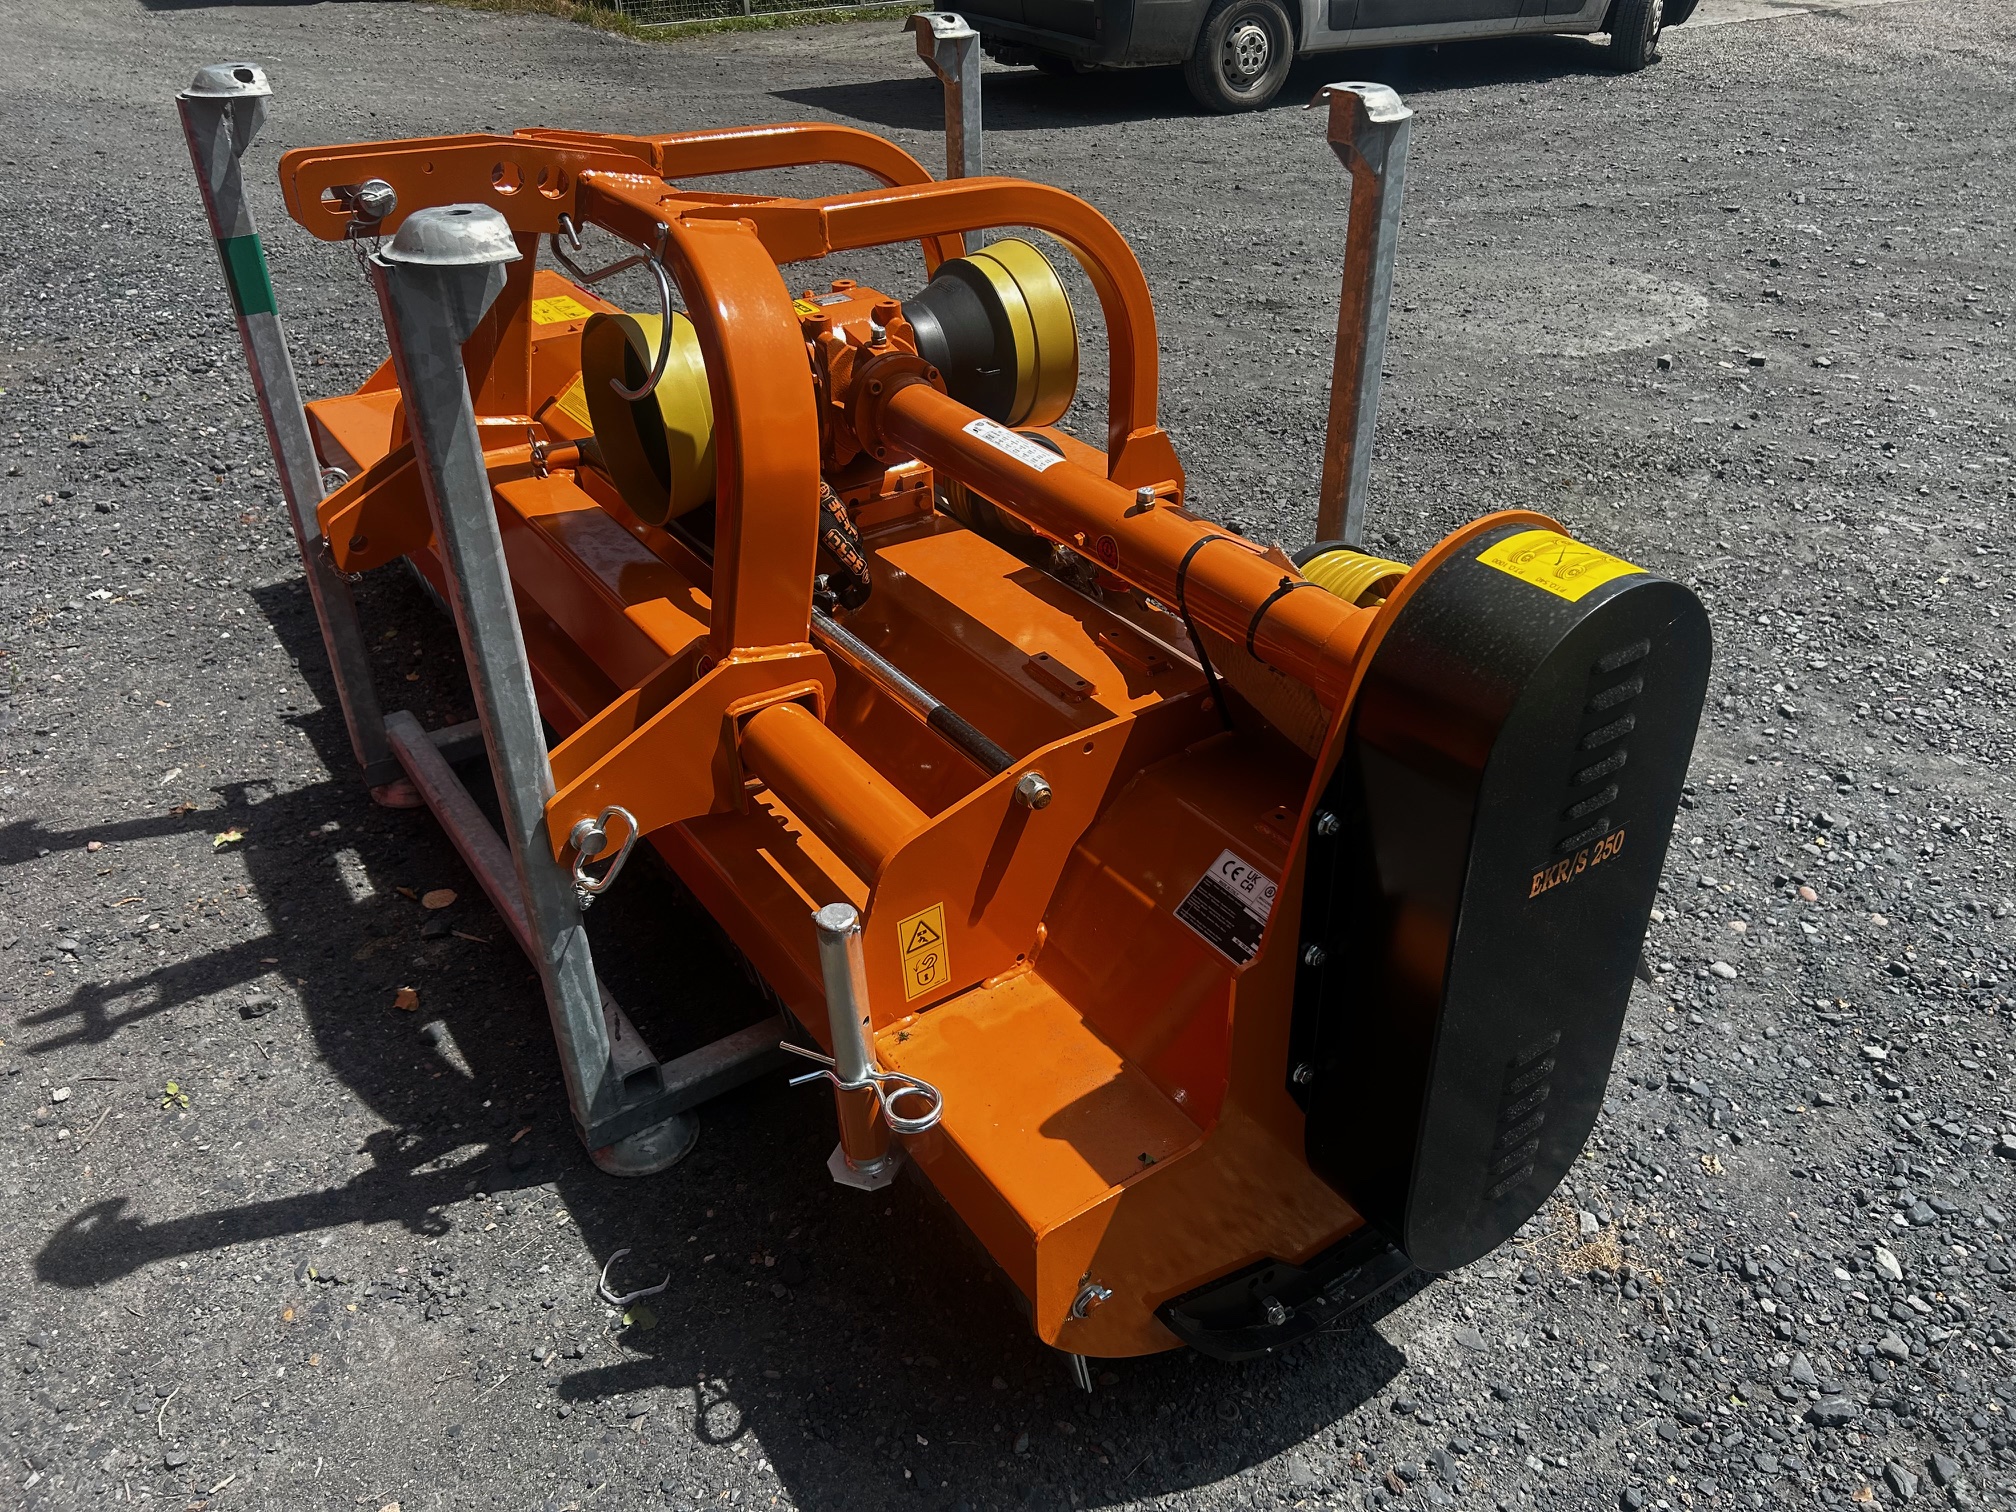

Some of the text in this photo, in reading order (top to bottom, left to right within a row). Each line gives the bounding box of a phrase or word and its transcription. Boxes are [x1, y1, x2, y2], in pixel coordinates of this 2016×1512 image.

[1491, 558, 1508, 568] 1000
[1535, 576, 1550, 586] 540
[1222, 860, 1245, 881] CE
[1528, 829, 1625, 899] EKR/S 250
[1246, 870, 1262, 885] UK
[1240, 879, 1254, 893] CA
